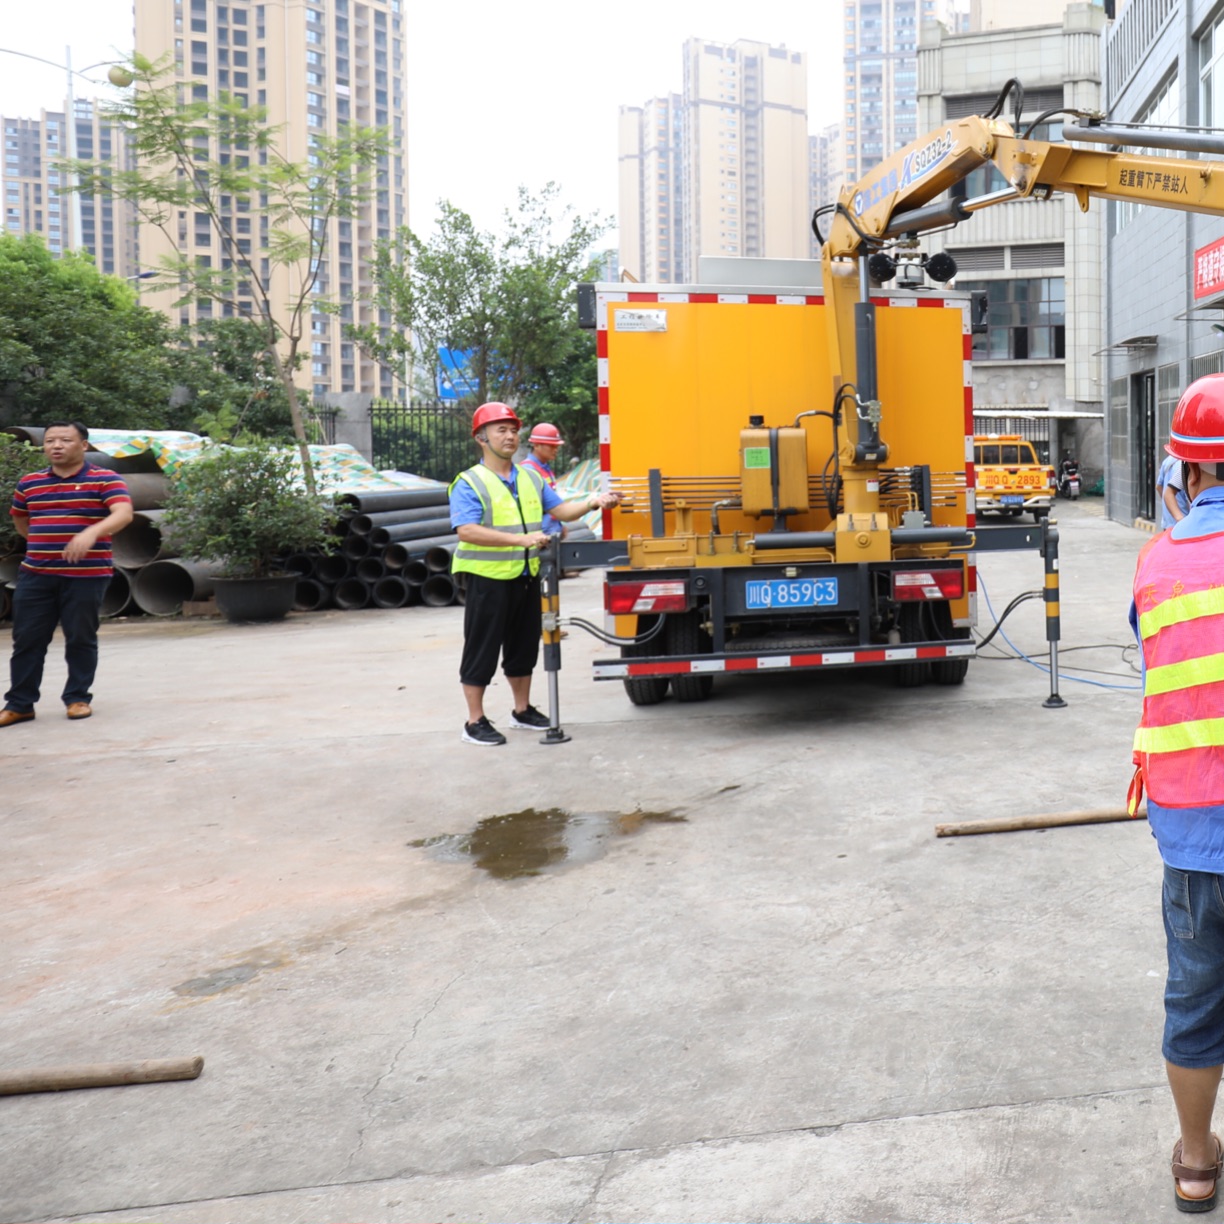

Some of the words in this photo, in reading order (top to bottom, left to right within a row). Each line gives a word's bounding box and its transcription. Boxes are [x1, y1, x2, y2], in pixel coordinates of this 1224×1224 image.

[915, 130, 953, 173] SQZ32-2
[1119, 168, 1188, 195] 起重臂下严禁站人
[1017, 474, 1041, 485] 2893
